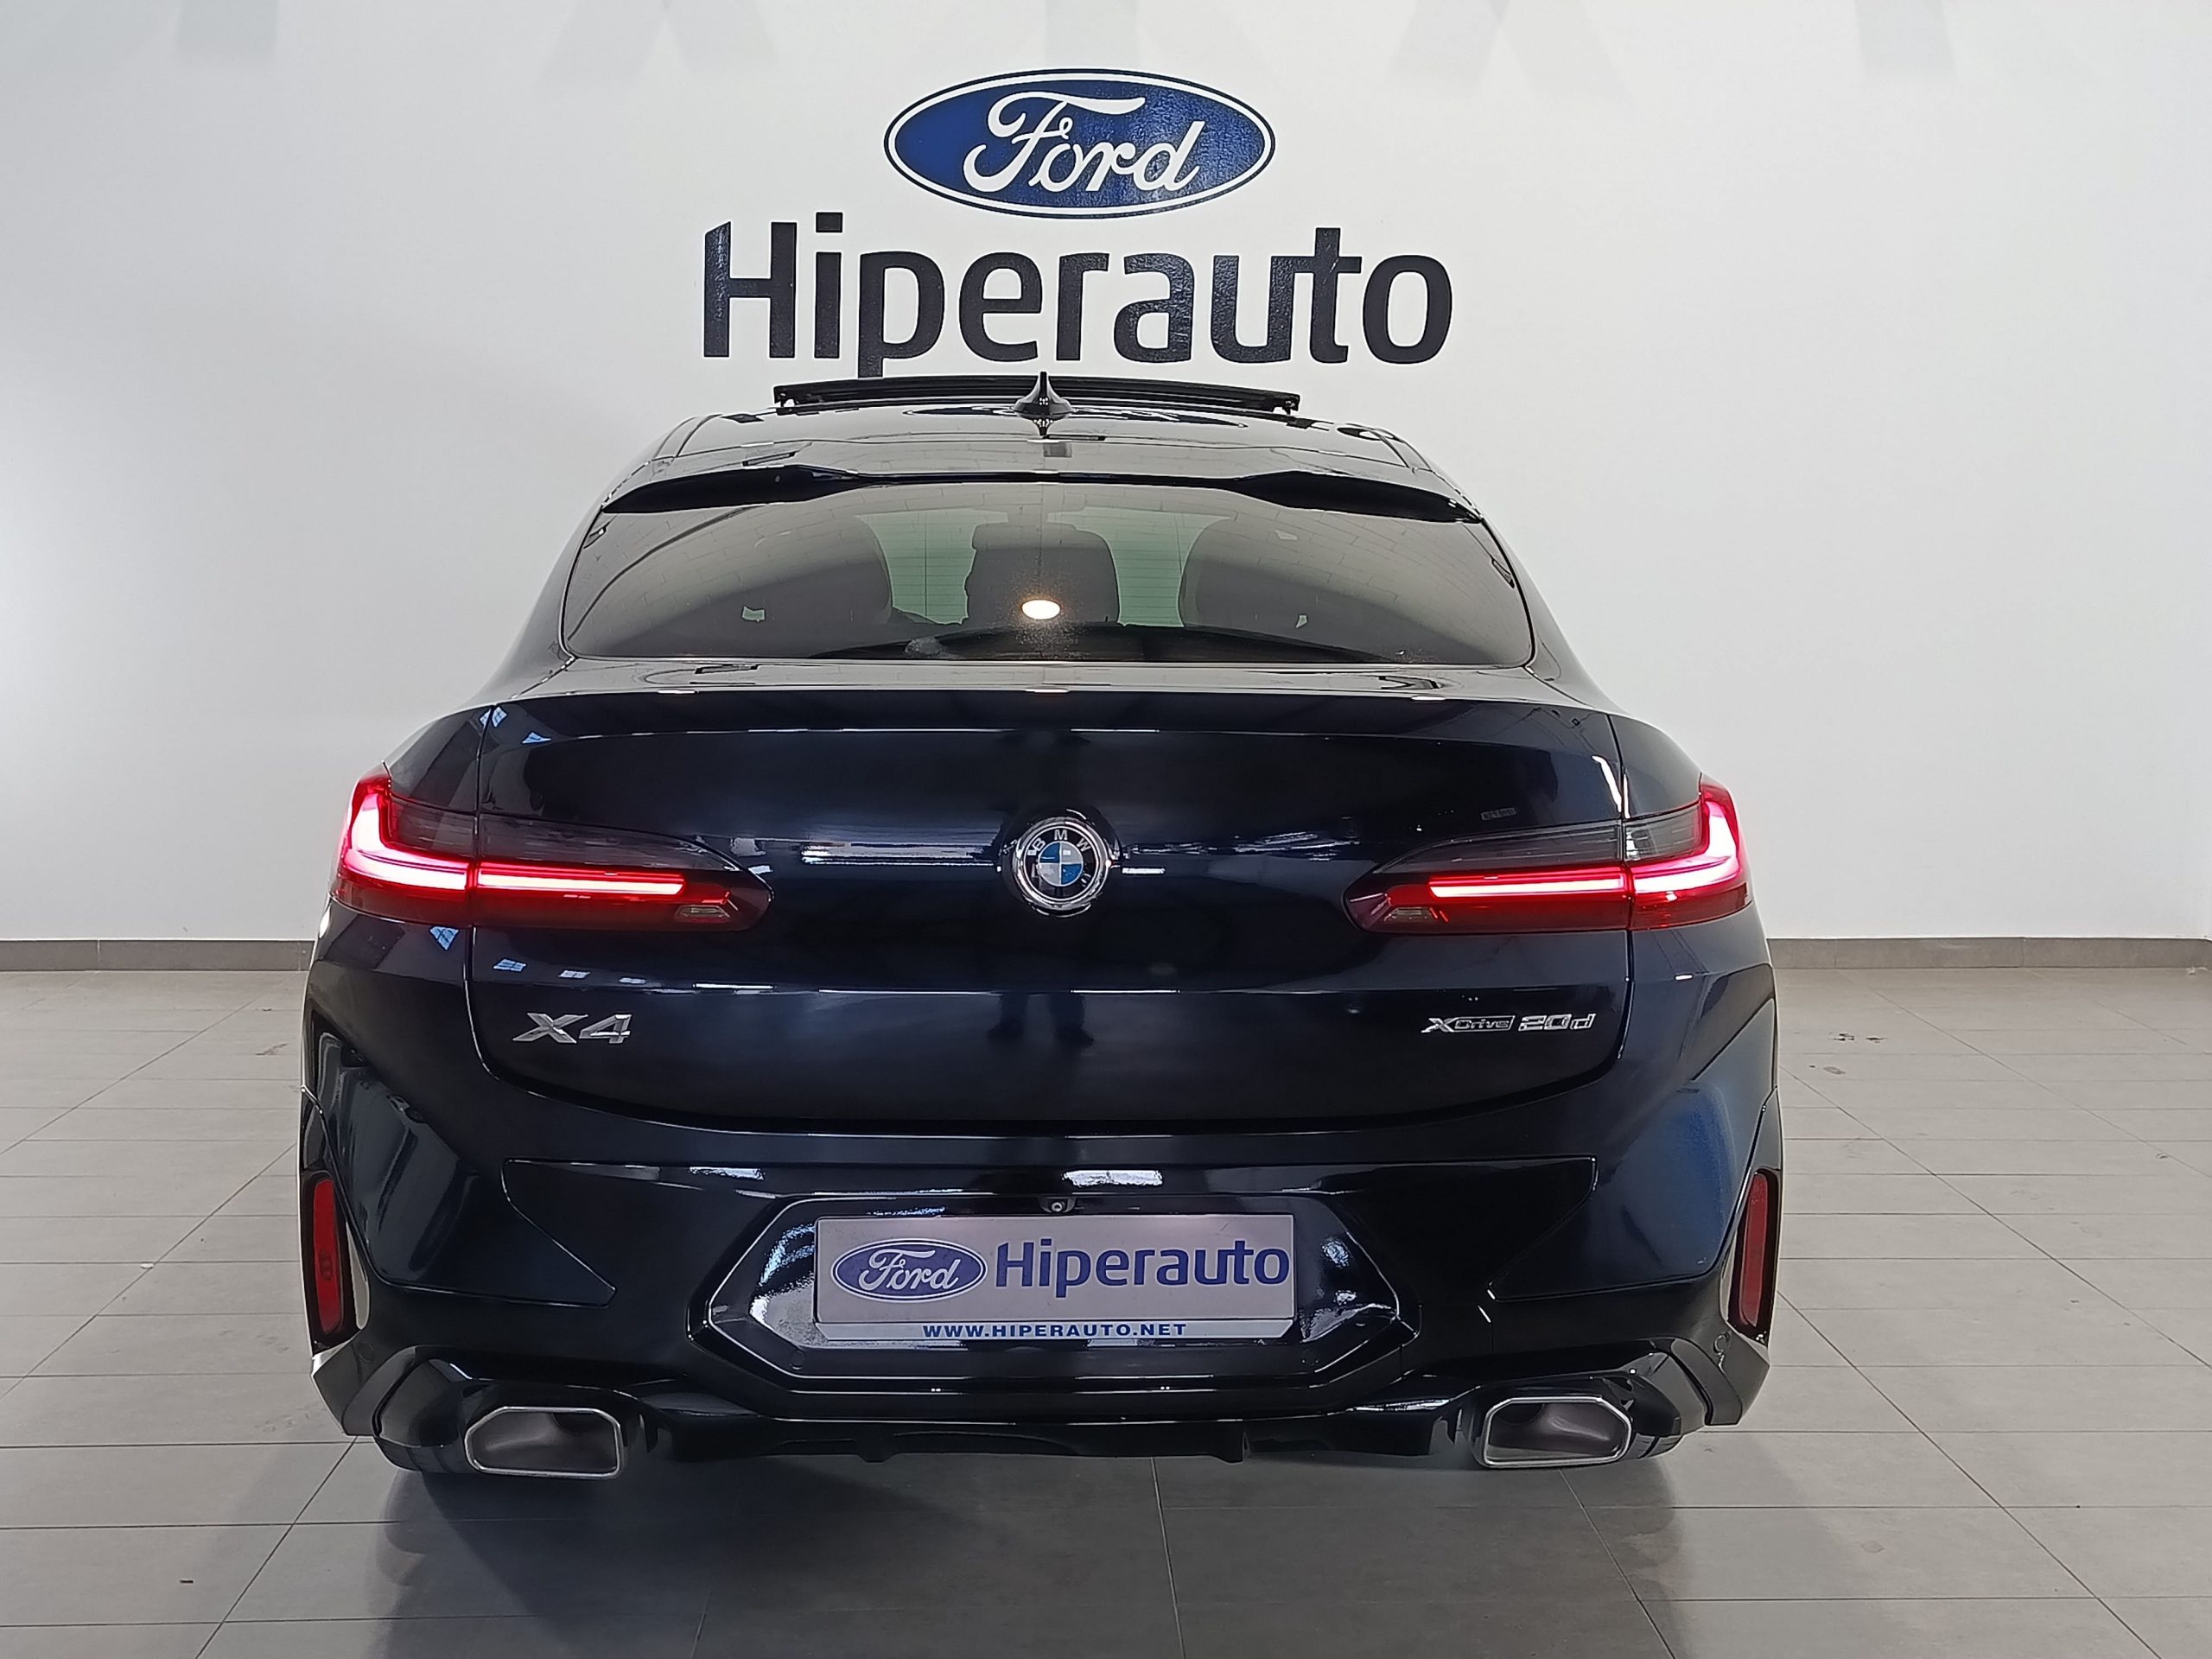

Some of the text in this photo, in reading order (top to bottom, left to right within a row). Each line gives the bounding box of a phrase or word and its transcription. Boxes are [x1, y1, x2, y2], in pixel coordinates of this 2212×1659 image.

[963, 92, 1205, 193] Ford
[703, 212, 1452, 378] Hiperauto
[1032, 829, 1091, 853] BMW
[512, 1013, 632, 1044] X4
[1518, 1014, 1596, 1032] 20d
[860, 1238, 1289, 1298] Ford Hiperauto
[923, 1323, 1187, 1338] WWW.HIPERAUTO.NET
